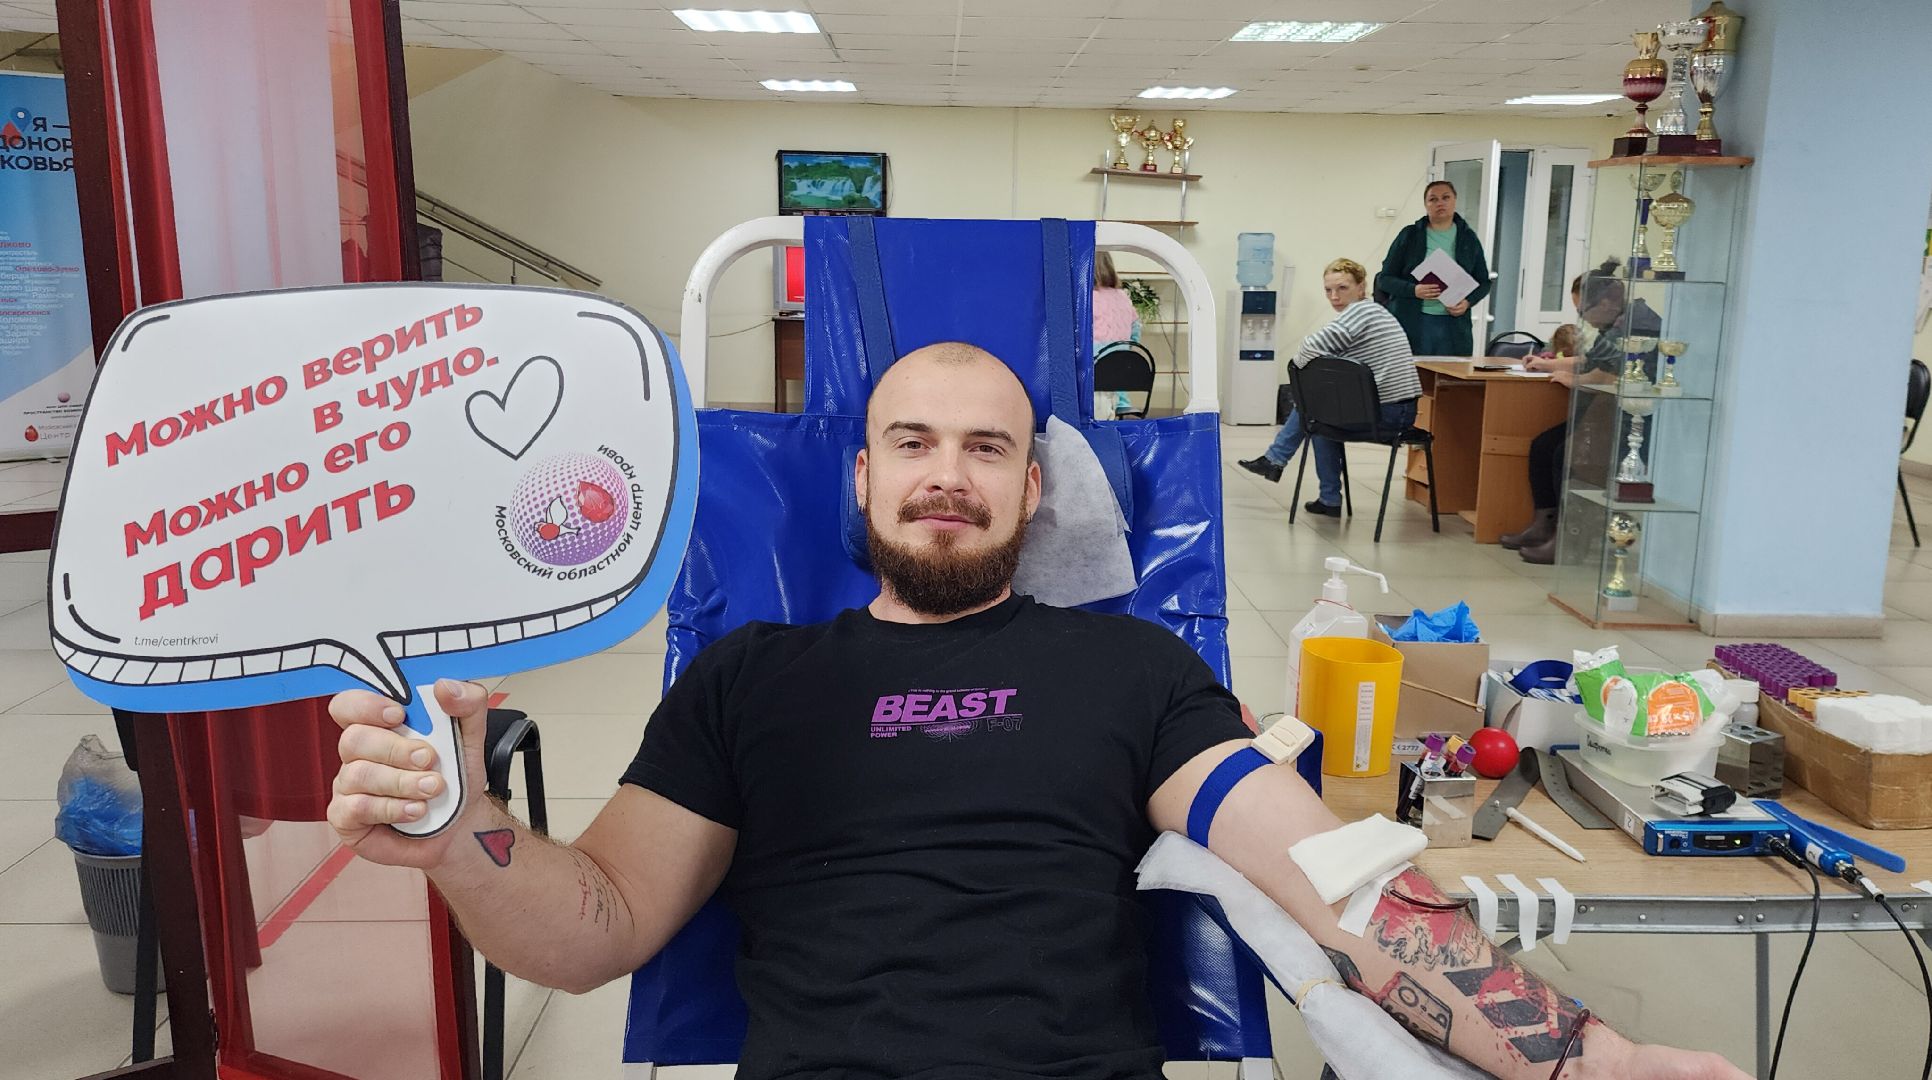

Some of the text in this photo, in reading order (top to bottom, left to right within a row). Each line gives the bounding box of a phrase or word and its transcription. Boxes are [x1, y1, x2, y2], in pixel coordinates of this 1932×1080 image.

[32, 116, 48, 132] Я
[105, 303, 484, 468] Можно верить
[312, 346, 500, 434] в чудо.
[123, 421, 412, 558] Можно его
[494, 444, 645, 581] Московский областной центр крови
[138, 479, 416, 622] дарить
[134, 633, 219, 648] t.me/centrkrovi
[871, 688, 1018, 723] BEAST
